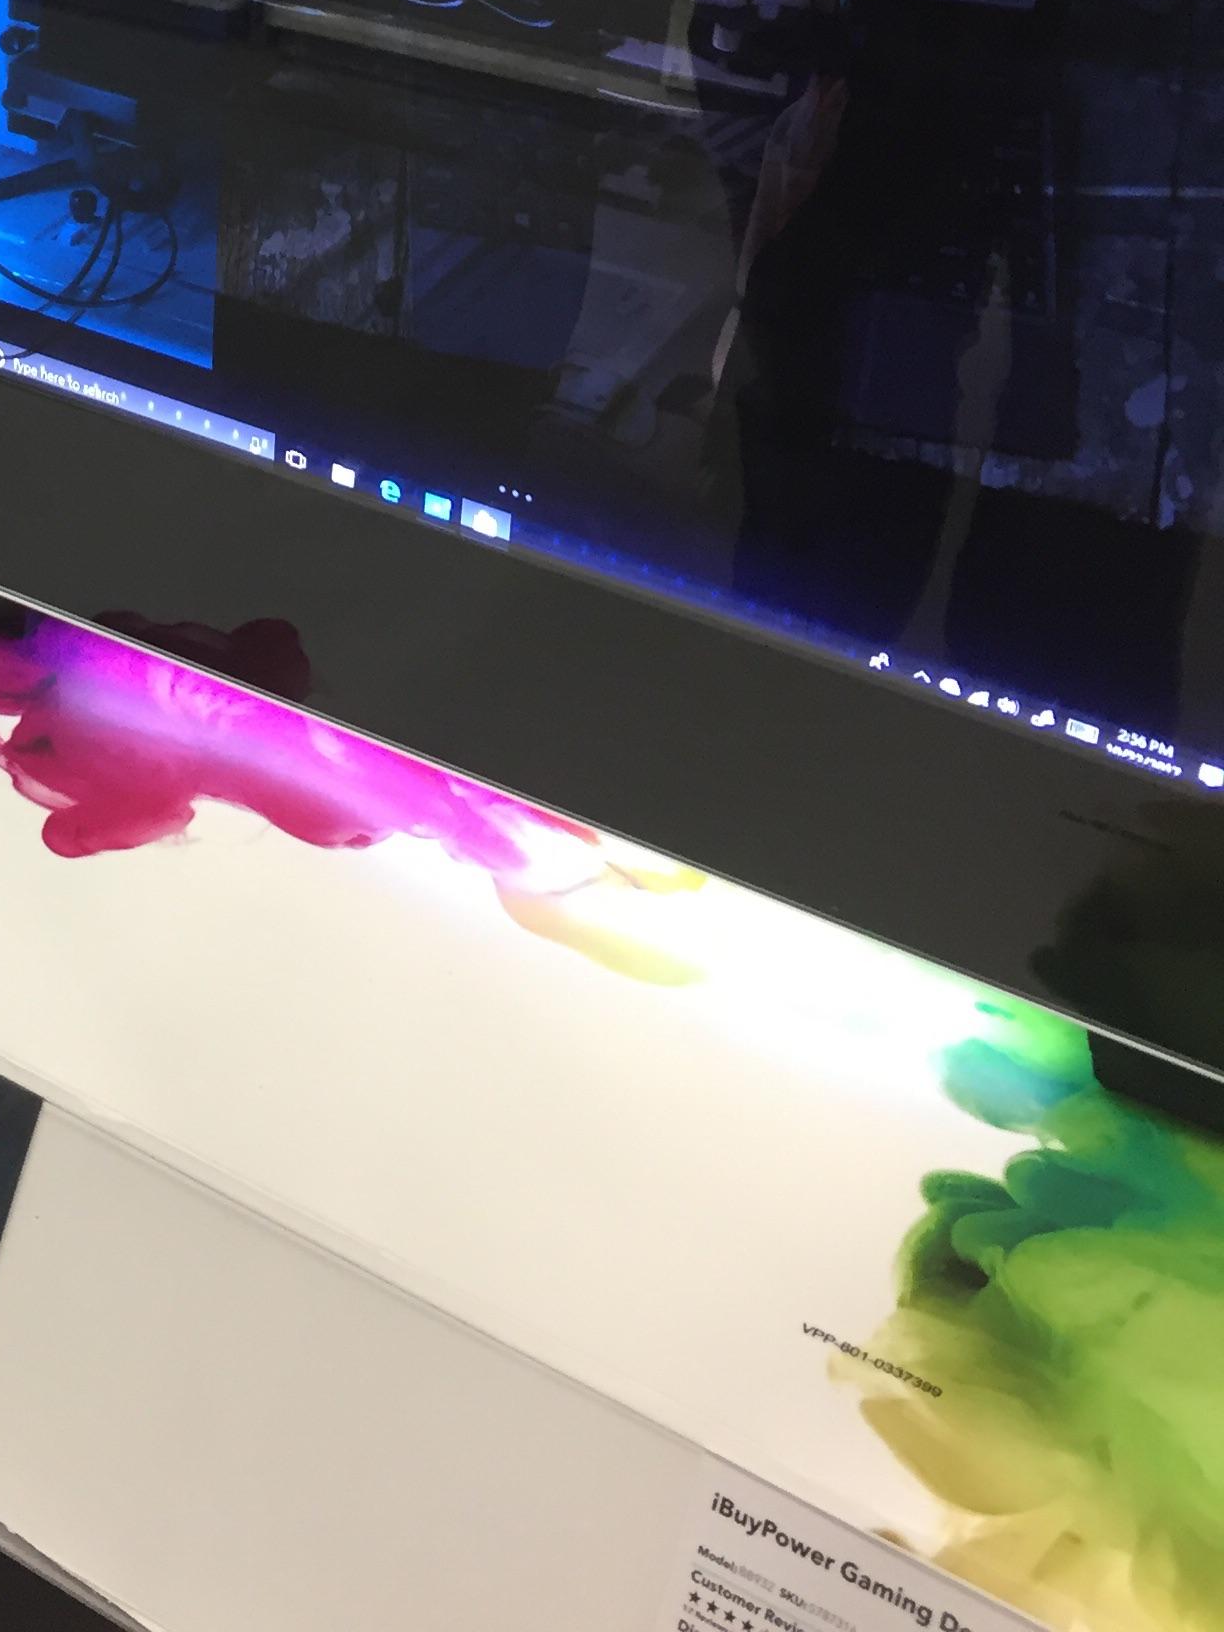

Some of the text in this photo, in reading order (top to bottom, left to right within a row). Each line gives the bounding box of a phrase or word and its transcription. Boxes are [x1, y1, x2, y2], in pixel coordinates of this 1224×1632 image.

[13, 357, 38, 381] Type
[39, 364, 65, 387] here
[66, 373, 80, 392] to
[1149, 738, 1174, 758] PM
[711, 1491, 836, 1571] iBuyPower
[840, 1561, 934, 1628] Gaming
[690, 1569, 762, 1615] Customer
